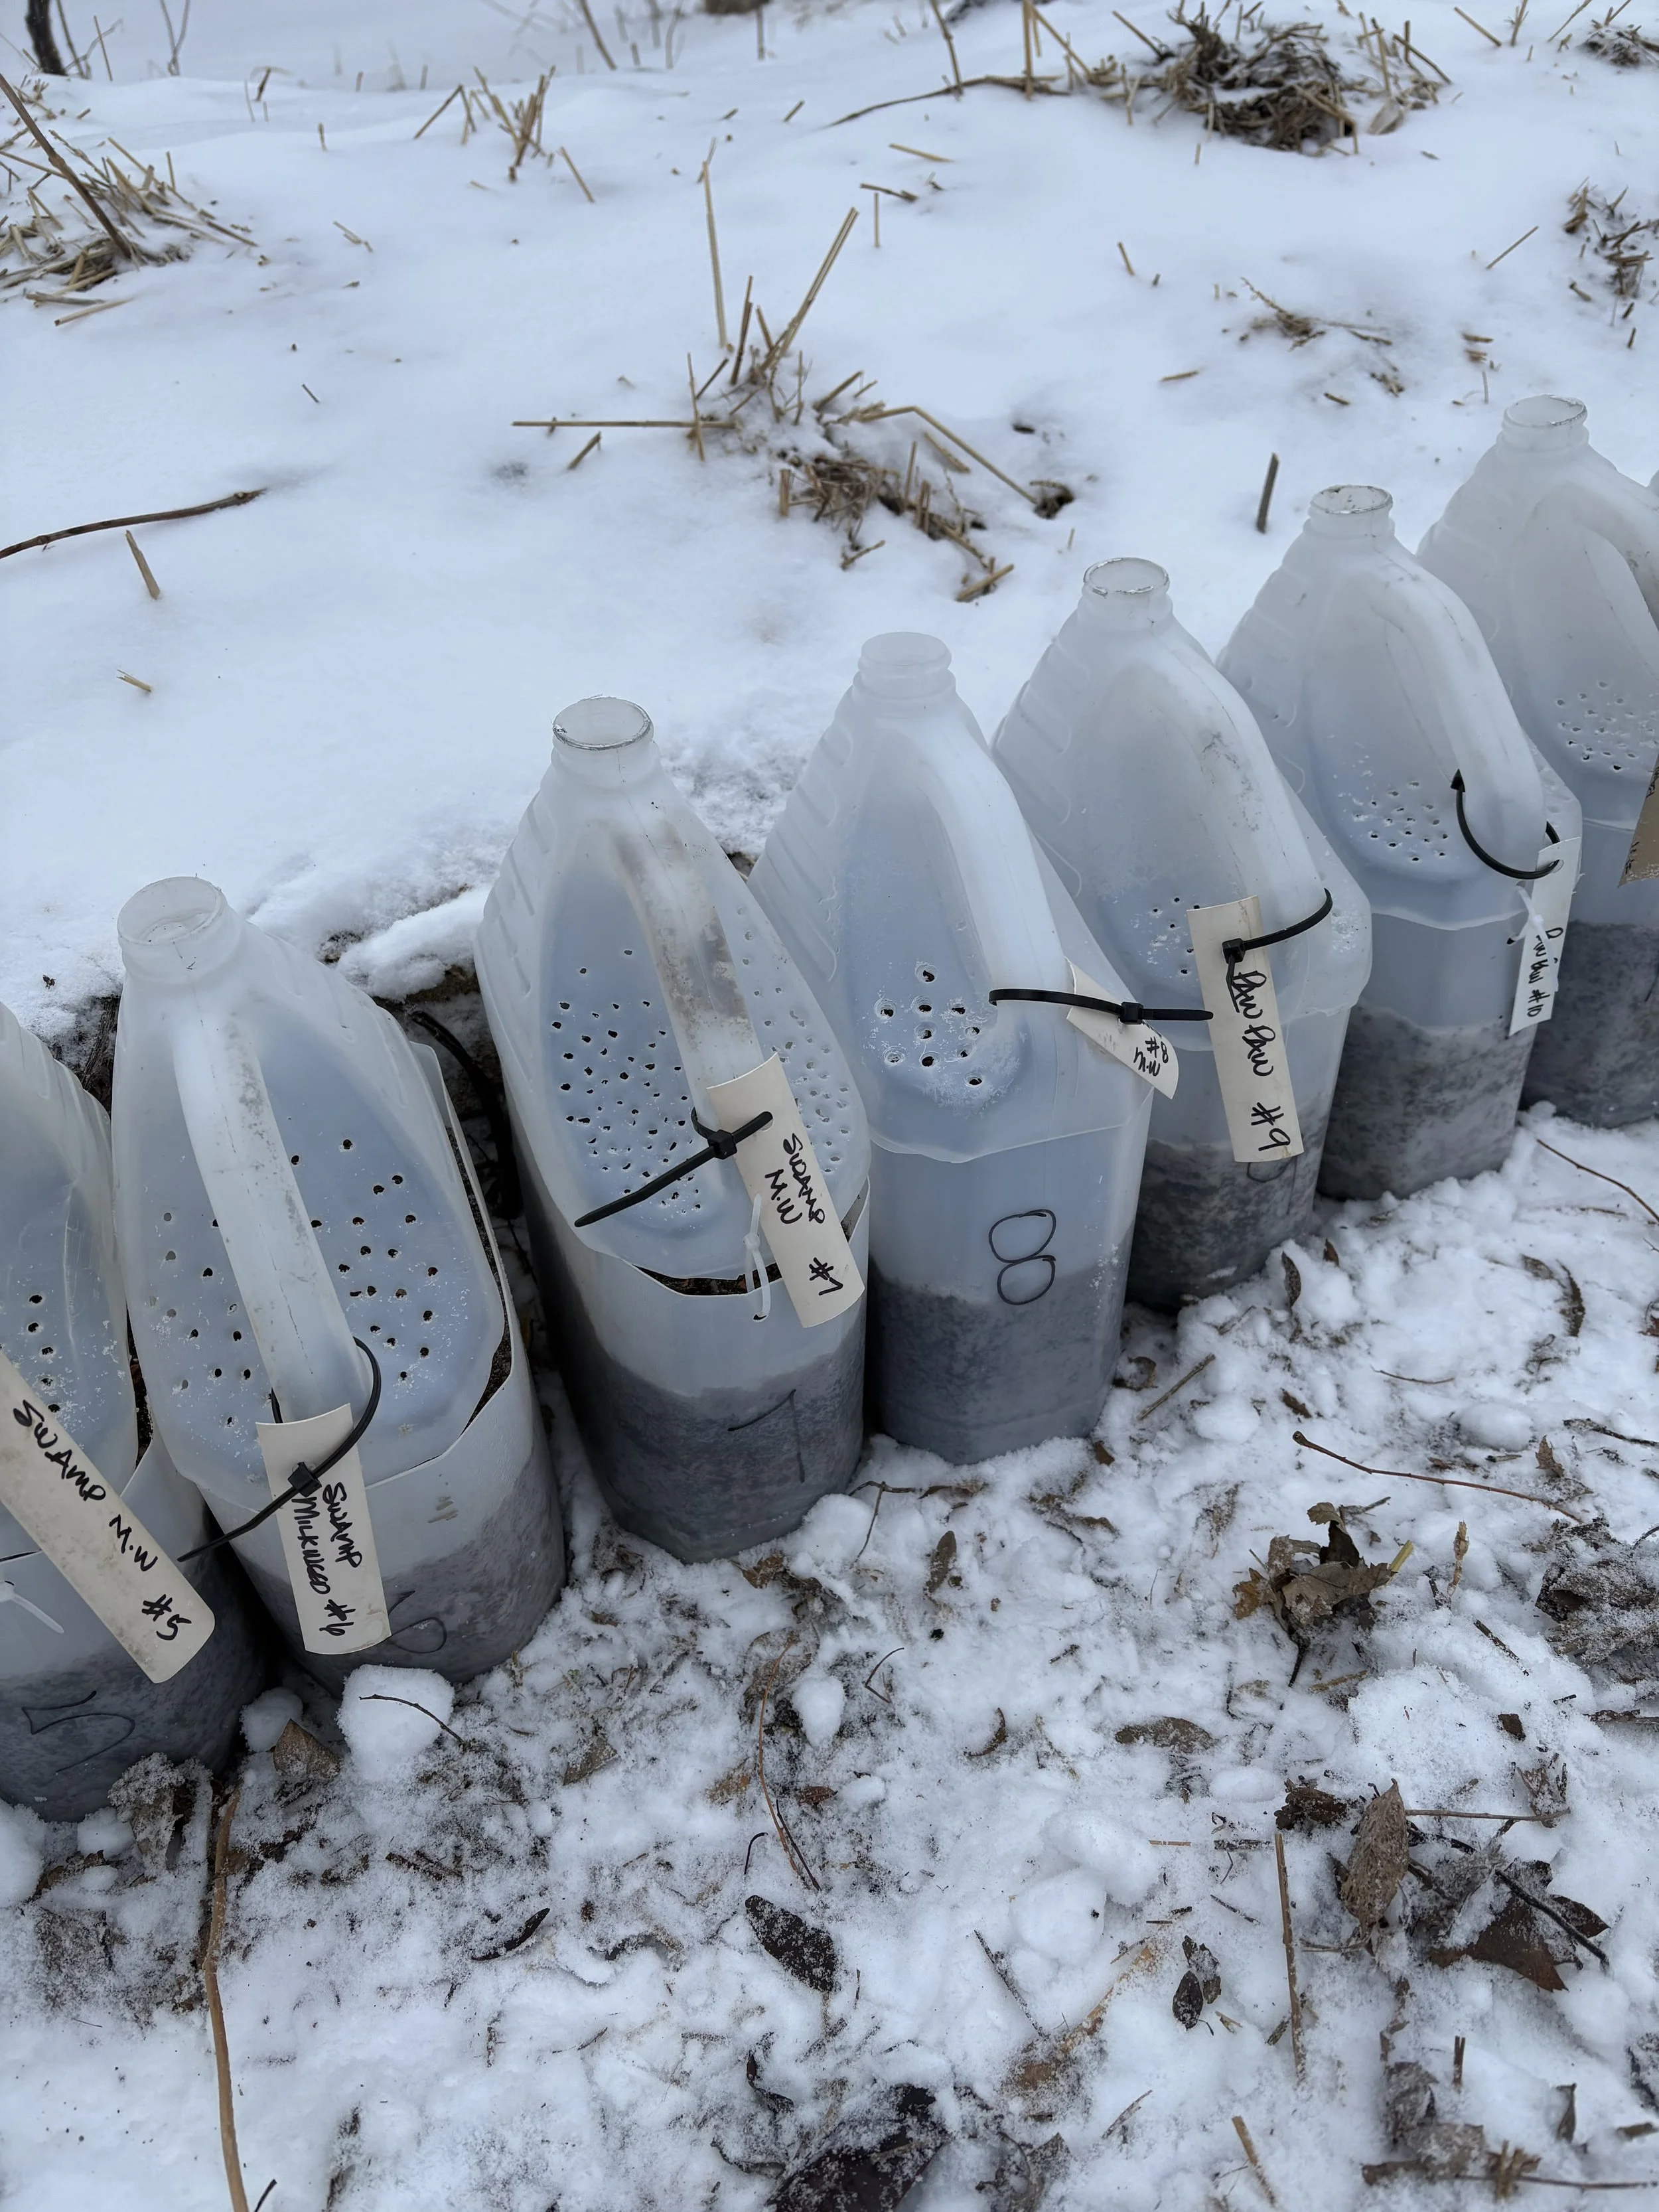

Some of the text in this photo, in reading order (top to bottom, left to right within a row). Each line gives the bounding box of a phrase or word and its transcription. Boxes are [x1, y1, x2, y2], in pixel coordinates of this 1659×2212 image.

[1231, 970, 1267, 1019] PAW
[1527, 989, 1551, 1017] #10
[1145, 1036, 1169, 1064] #8
[1242, 1024, 1276, 1077] PAW
[1251, 1102, 1291, 1152] #9
[783, 1132, 825, 1224] SWAMP
[809, 1257, 843, 1296] #7
[988, 1209, 1056, 1305] 8
[13, 1399, 106, 1502] SWAMP
[141, 1593, 192, 1641] #5
[323, 1482, 363, 1568] SWAMP
[291, 1496, 356, 1637] MILKWEED #6
[21, 1690, 135, 1775] 5
